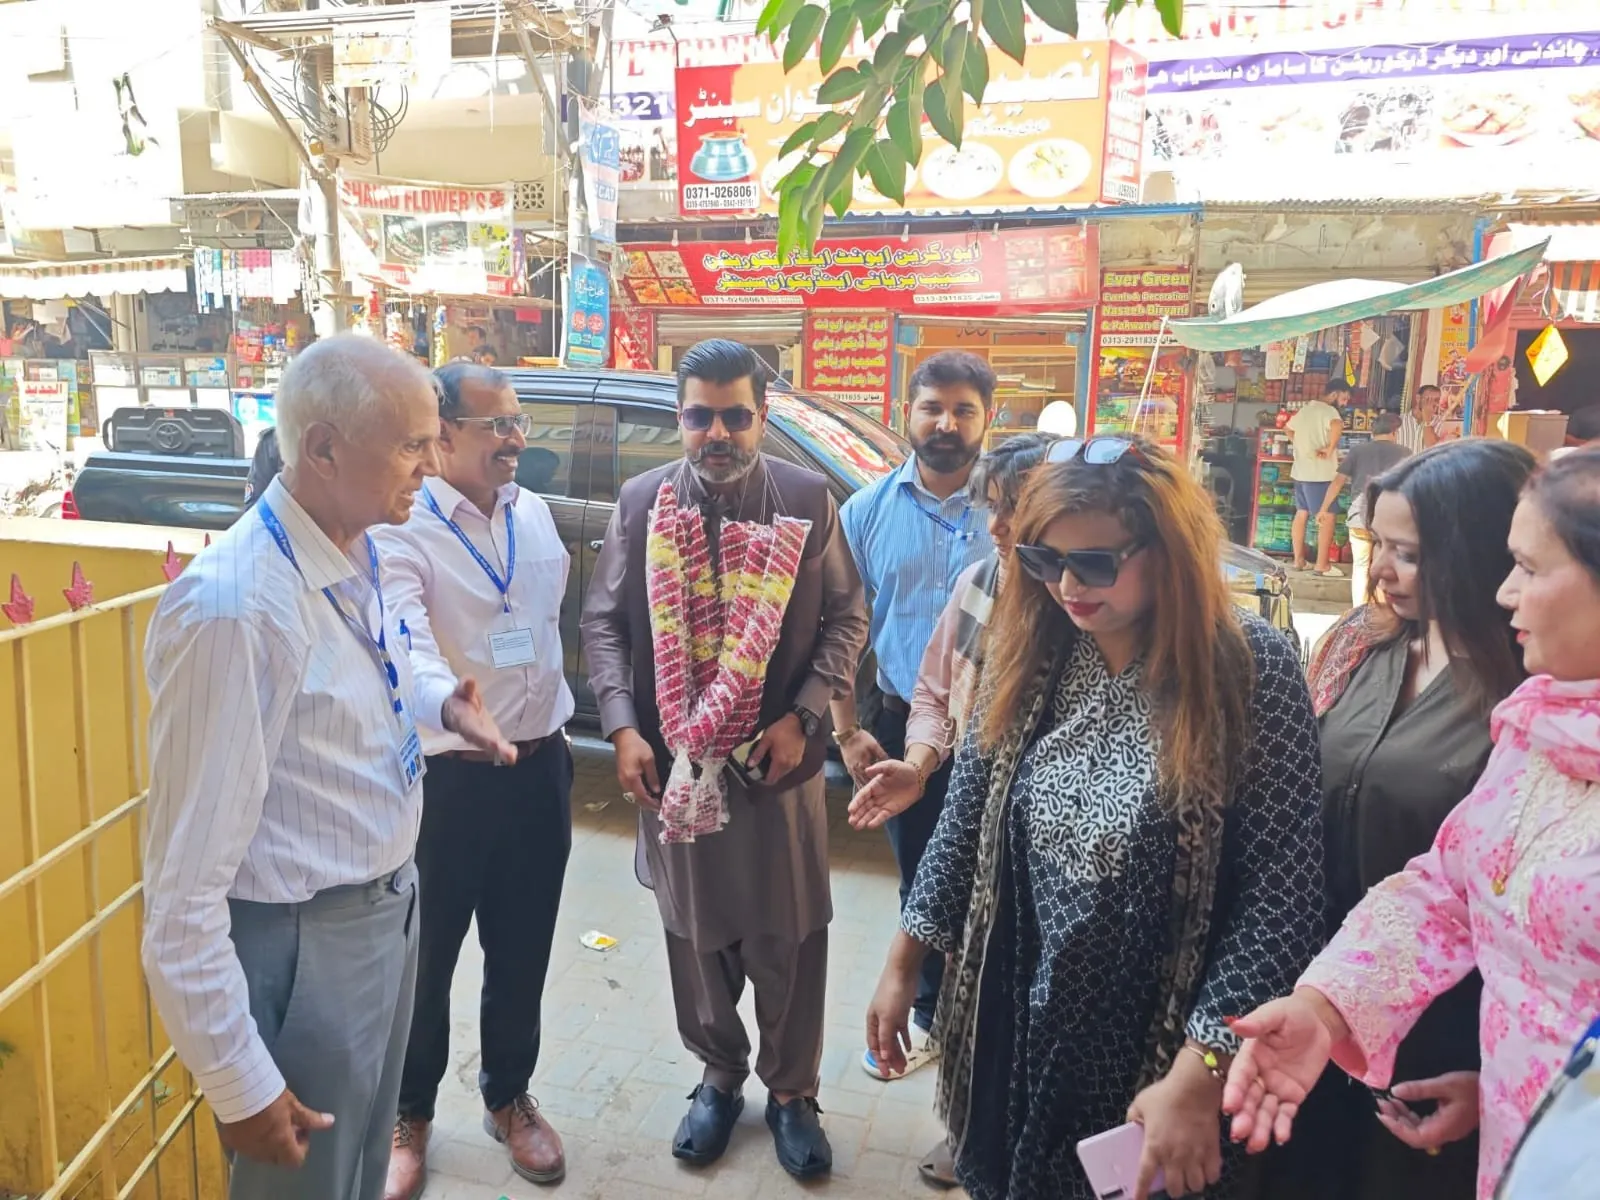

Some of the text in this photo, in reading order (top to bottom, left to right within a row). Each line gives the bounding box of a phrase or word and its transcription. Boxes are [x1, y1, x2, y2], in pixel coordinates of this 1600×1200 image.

[1310, 56, 1327, 74] کا
[1429, 44, 1477, 70] دیگر
[1478, 42, 1509, 67] اور
[683, 87, 761, 128] سینٹر
[404, 187, 487, 214] FLOWER'S
[1142, 272, 1190, 286] Green
